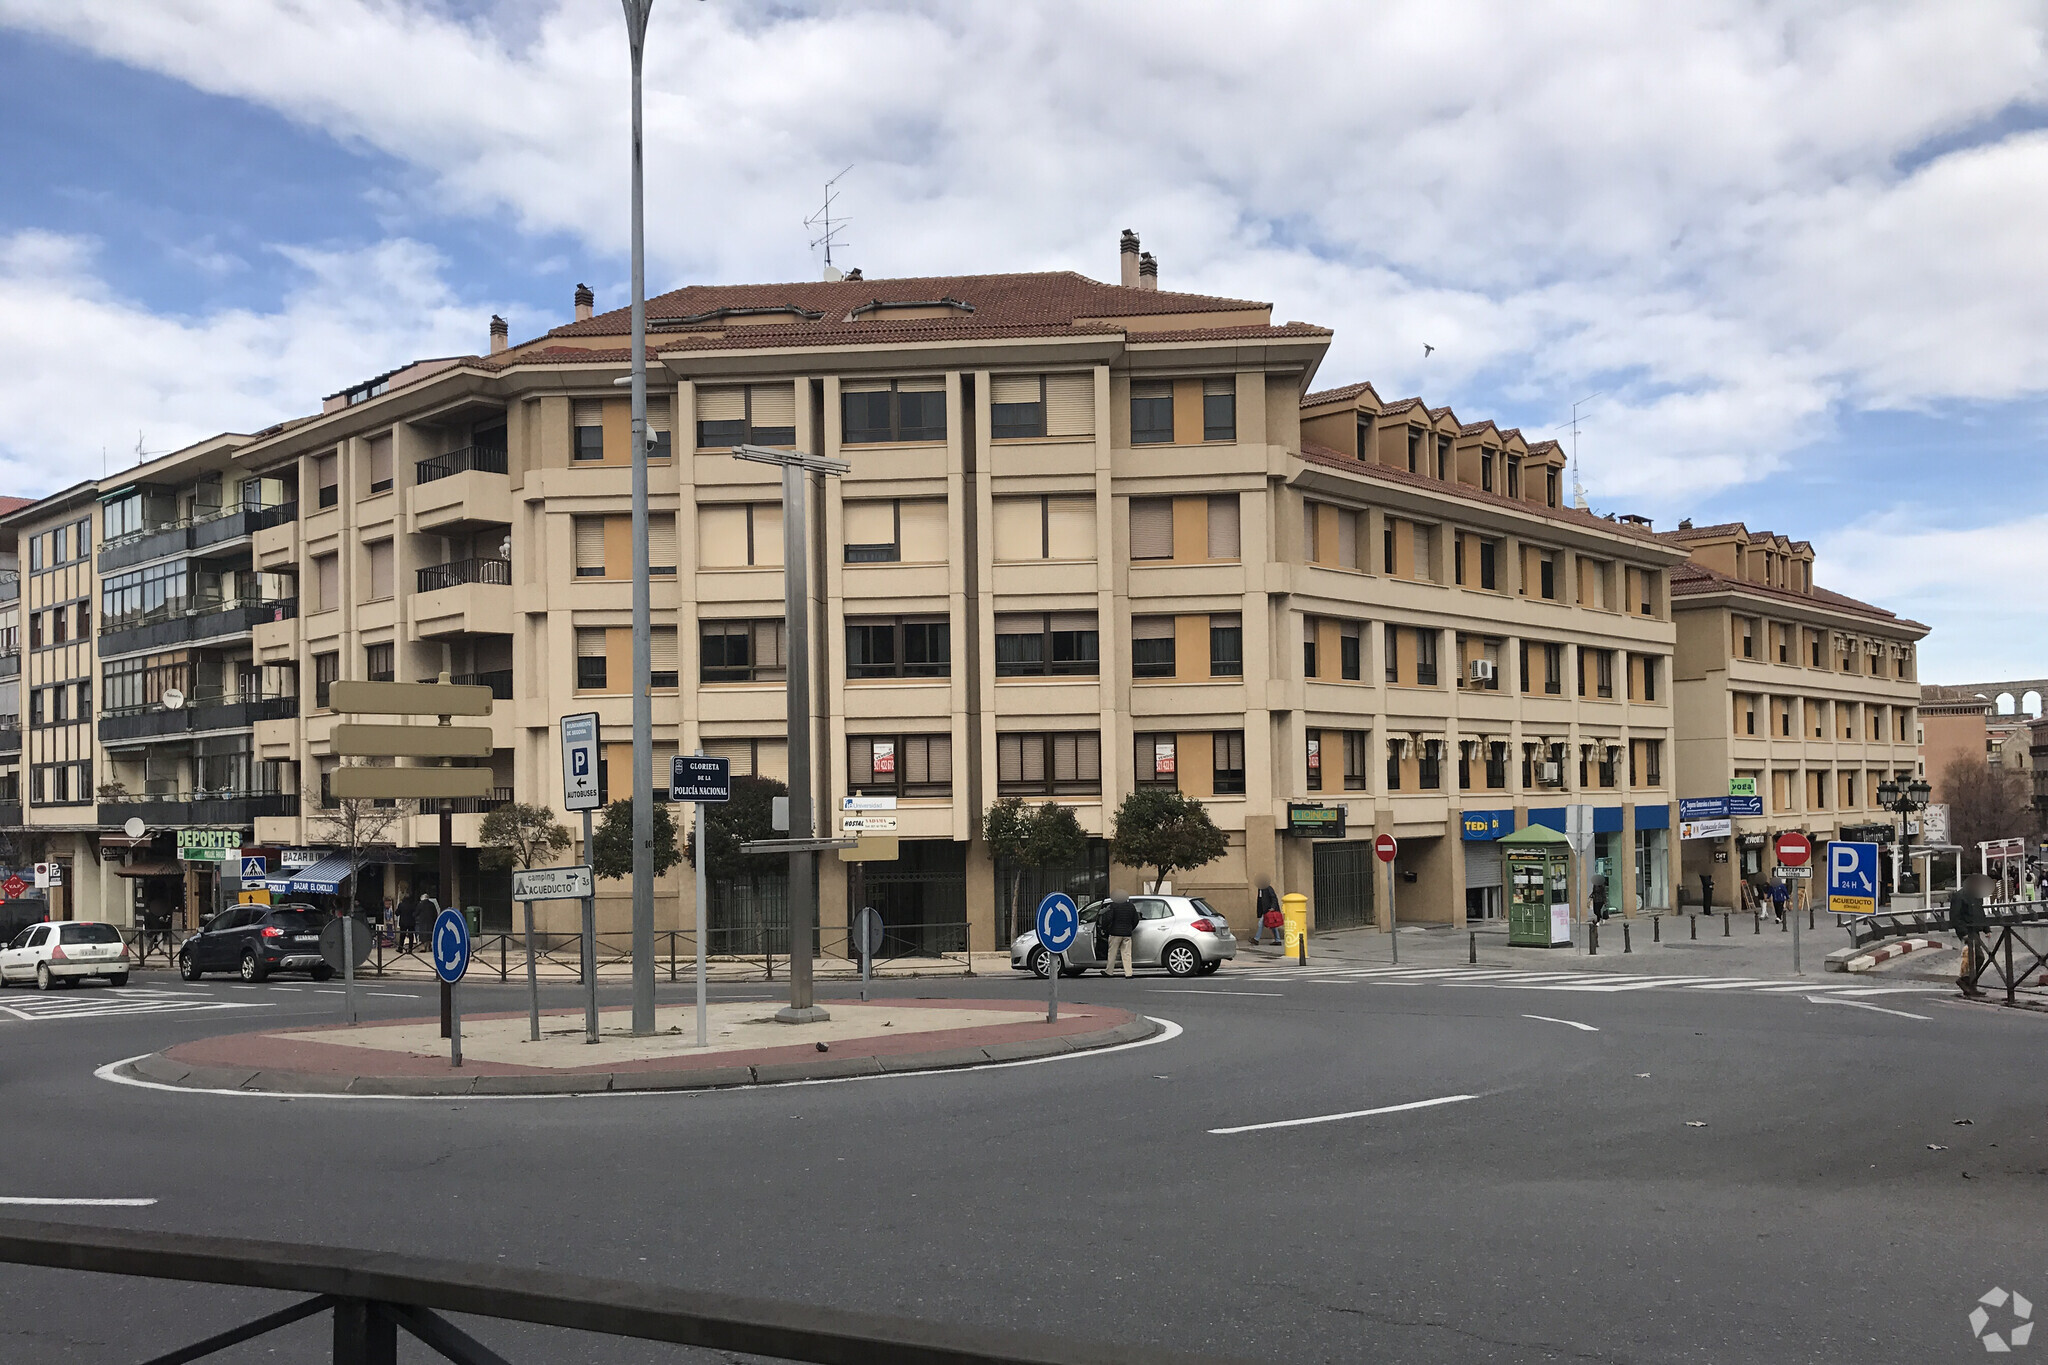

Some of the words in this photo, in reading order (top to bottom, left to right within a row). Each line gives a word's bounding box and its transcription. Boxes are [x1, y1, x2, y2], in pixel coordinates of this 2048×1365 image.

[575, 752, 586, 774] P
[567, 789, 597, 799] AUTOBUSES
[675, 785, 698, 795] POLICÍA
[699, 787, 727, 795] NACIONAL
[1302, 810, 1336, 820] ONCE
[1464, 821, 1488, 831] TEDi
[177, 830, 241, 848] DEPORTES
[283, 852, 308, 862] BAZAR
[1832, 846, 1860, 888] P
[528, 873, 555, 882] camping
[293, 882, 309, 890] BAZAR
[310, 883, 316, 891] EL
[316, 884, 334, 892] CHOLLO
[1852, 881, 1857, 889] H
[1832, 898, 1872, 906] ACUEDUCTO
